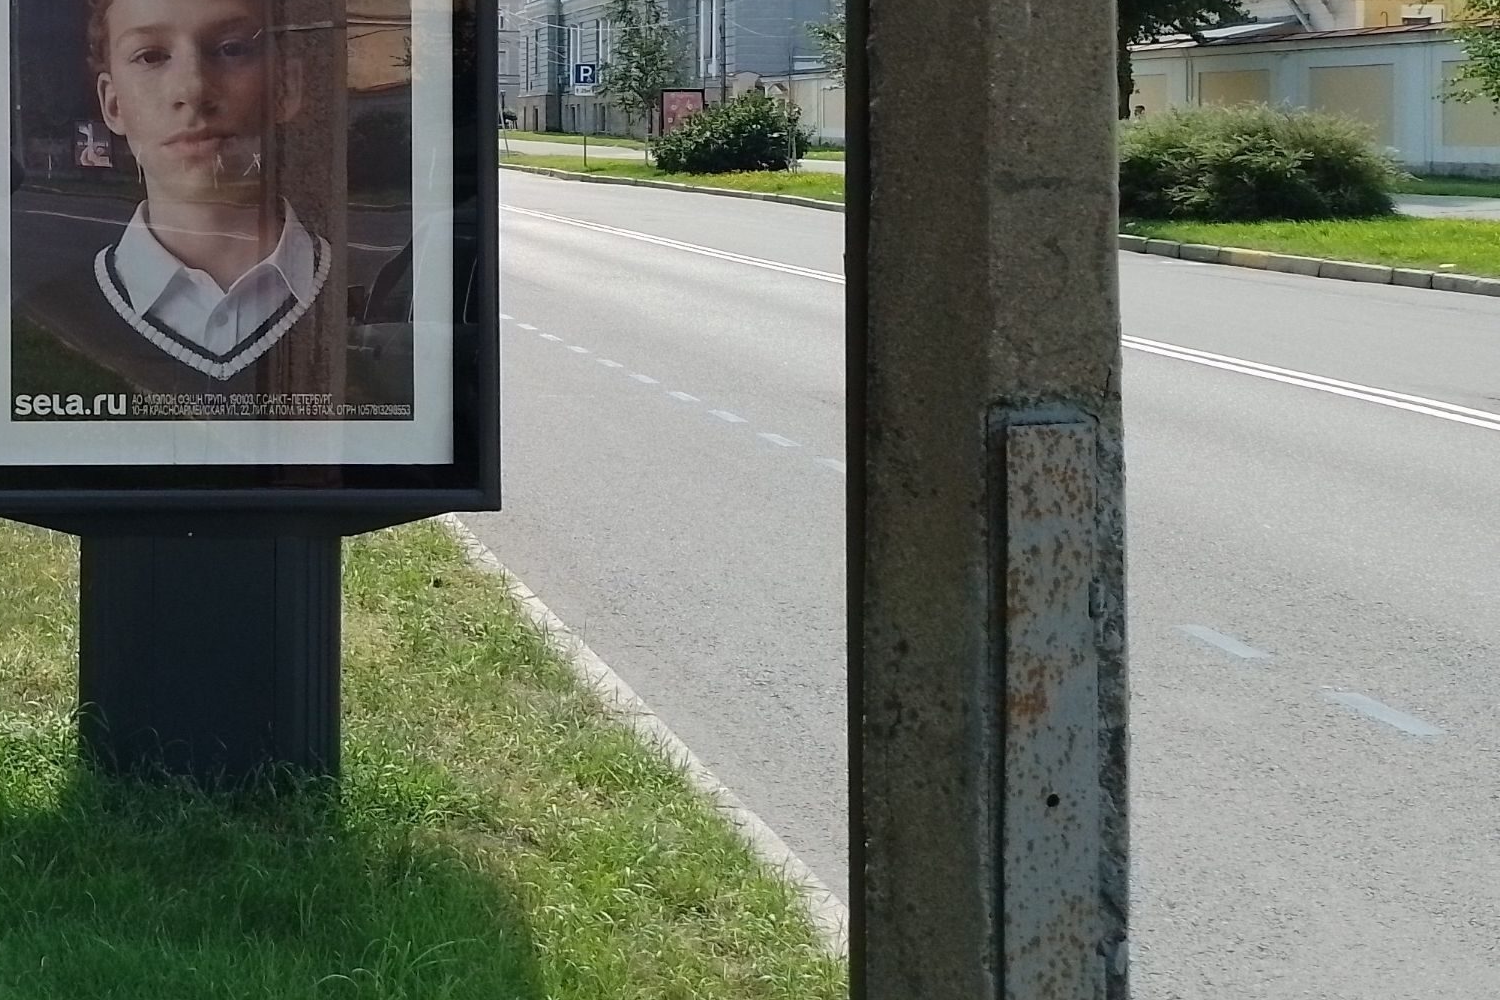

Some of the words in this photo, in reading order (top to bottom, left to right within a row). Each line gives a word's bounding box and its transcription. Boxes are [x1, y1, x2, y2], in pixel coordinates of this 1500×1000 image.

[15, 394, 127, 415] sela.ru
[132, 393, 143, 405] АО
[337, 404, 357, 416] ОГРН
